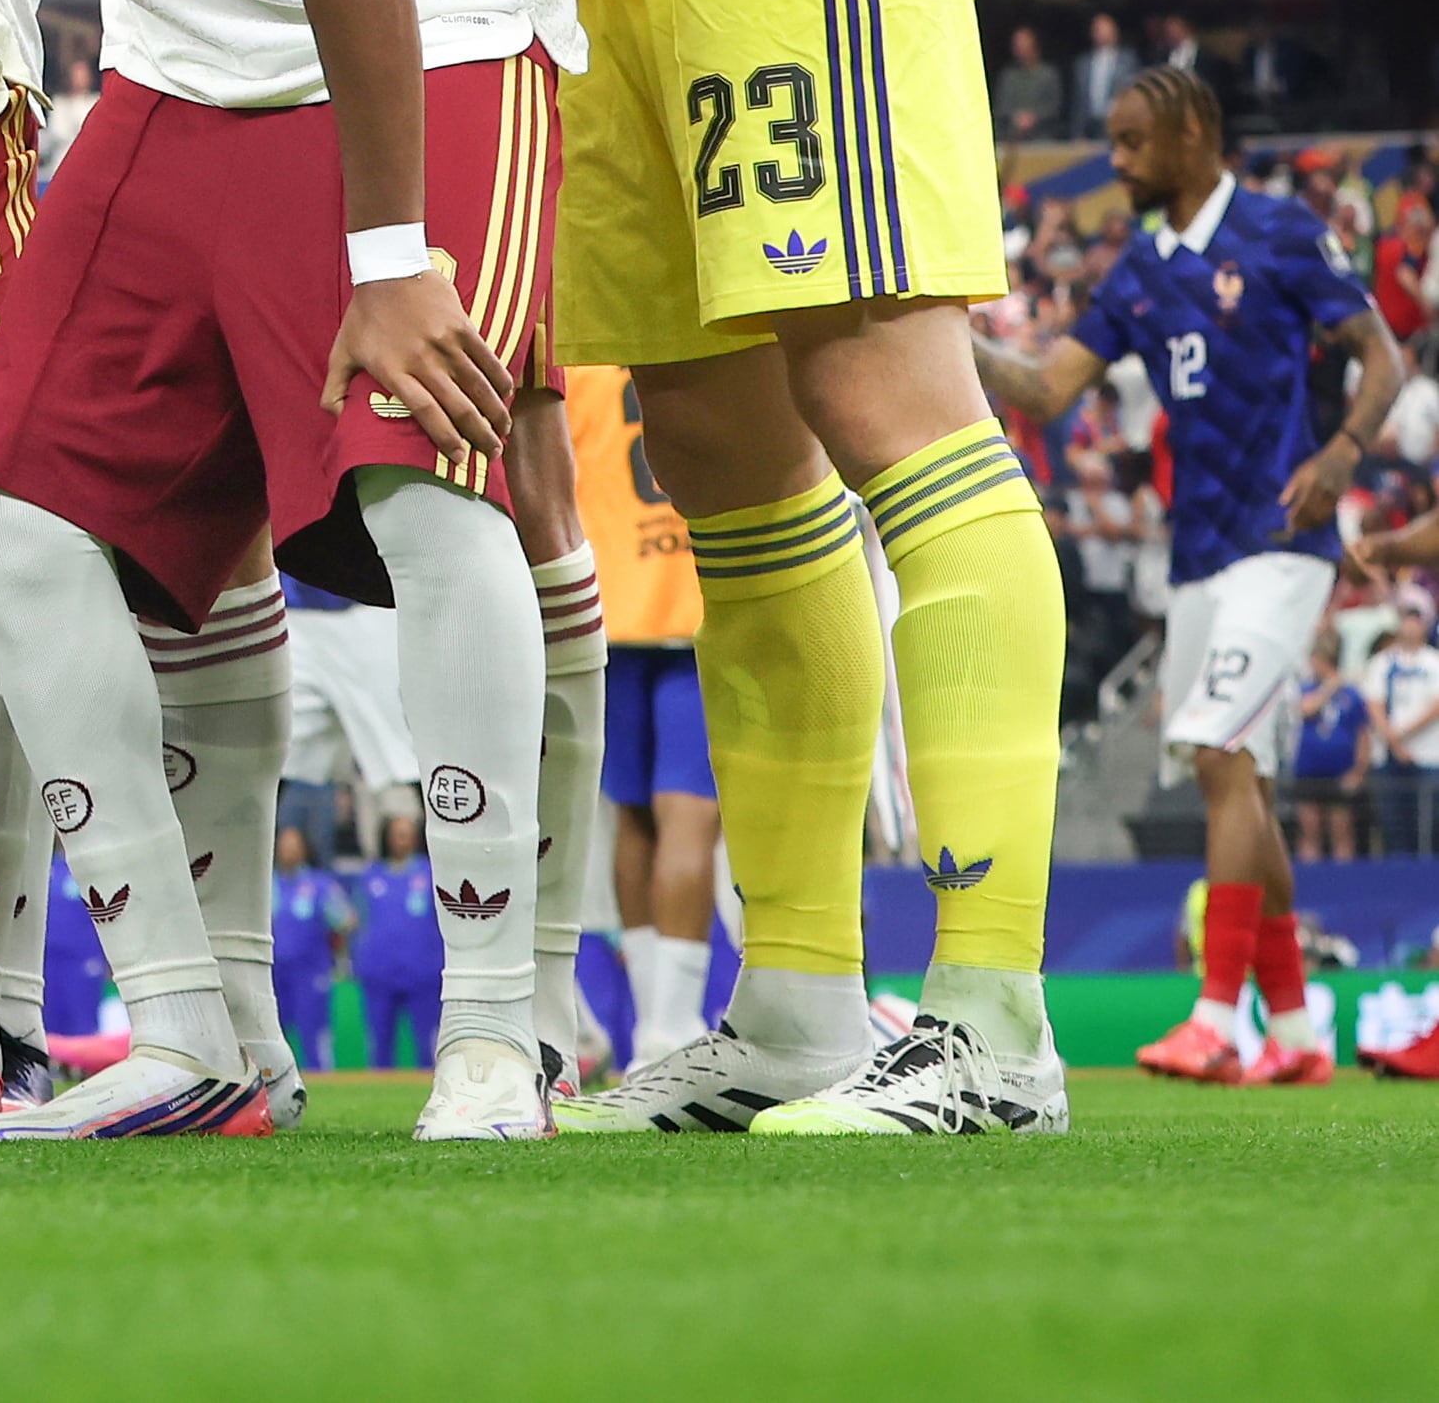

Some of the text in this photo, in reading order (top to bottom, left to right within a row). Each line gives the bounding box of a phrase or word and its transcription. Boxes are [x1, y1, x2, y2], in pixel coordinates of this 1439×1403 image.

[688, 62, 827, 219] 23
[1166, 331, 1208, 398] 12
[437, 776, 468, 795] RF
[45, 788, 73, 807] RF
[436, 794, 469, 811] EF
[53, 804, 78, 823] EF
